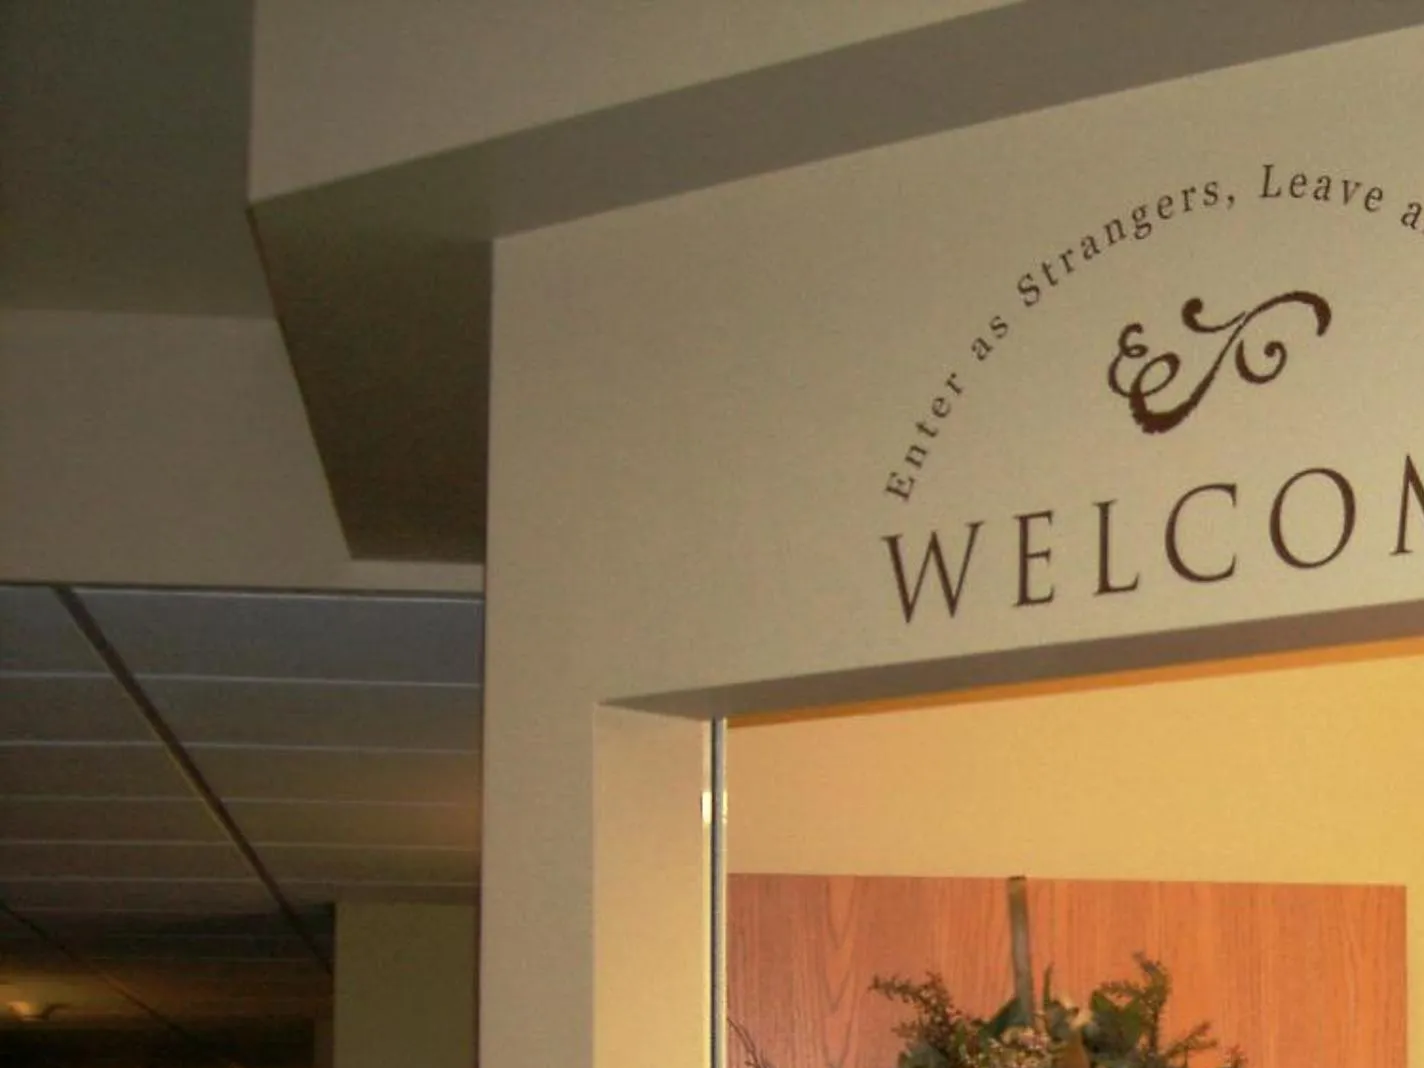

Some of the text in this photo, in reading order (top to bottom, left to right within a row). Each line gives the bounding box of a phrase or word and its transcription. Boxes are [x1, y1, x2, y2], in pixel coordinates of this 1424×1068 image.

[885, 372, 963, 502] Enter
[970, 315, 1009, 361] as
[1017, 181, 1235, 308] Strangers,
[1259, 164, 1384, 213] Leave
